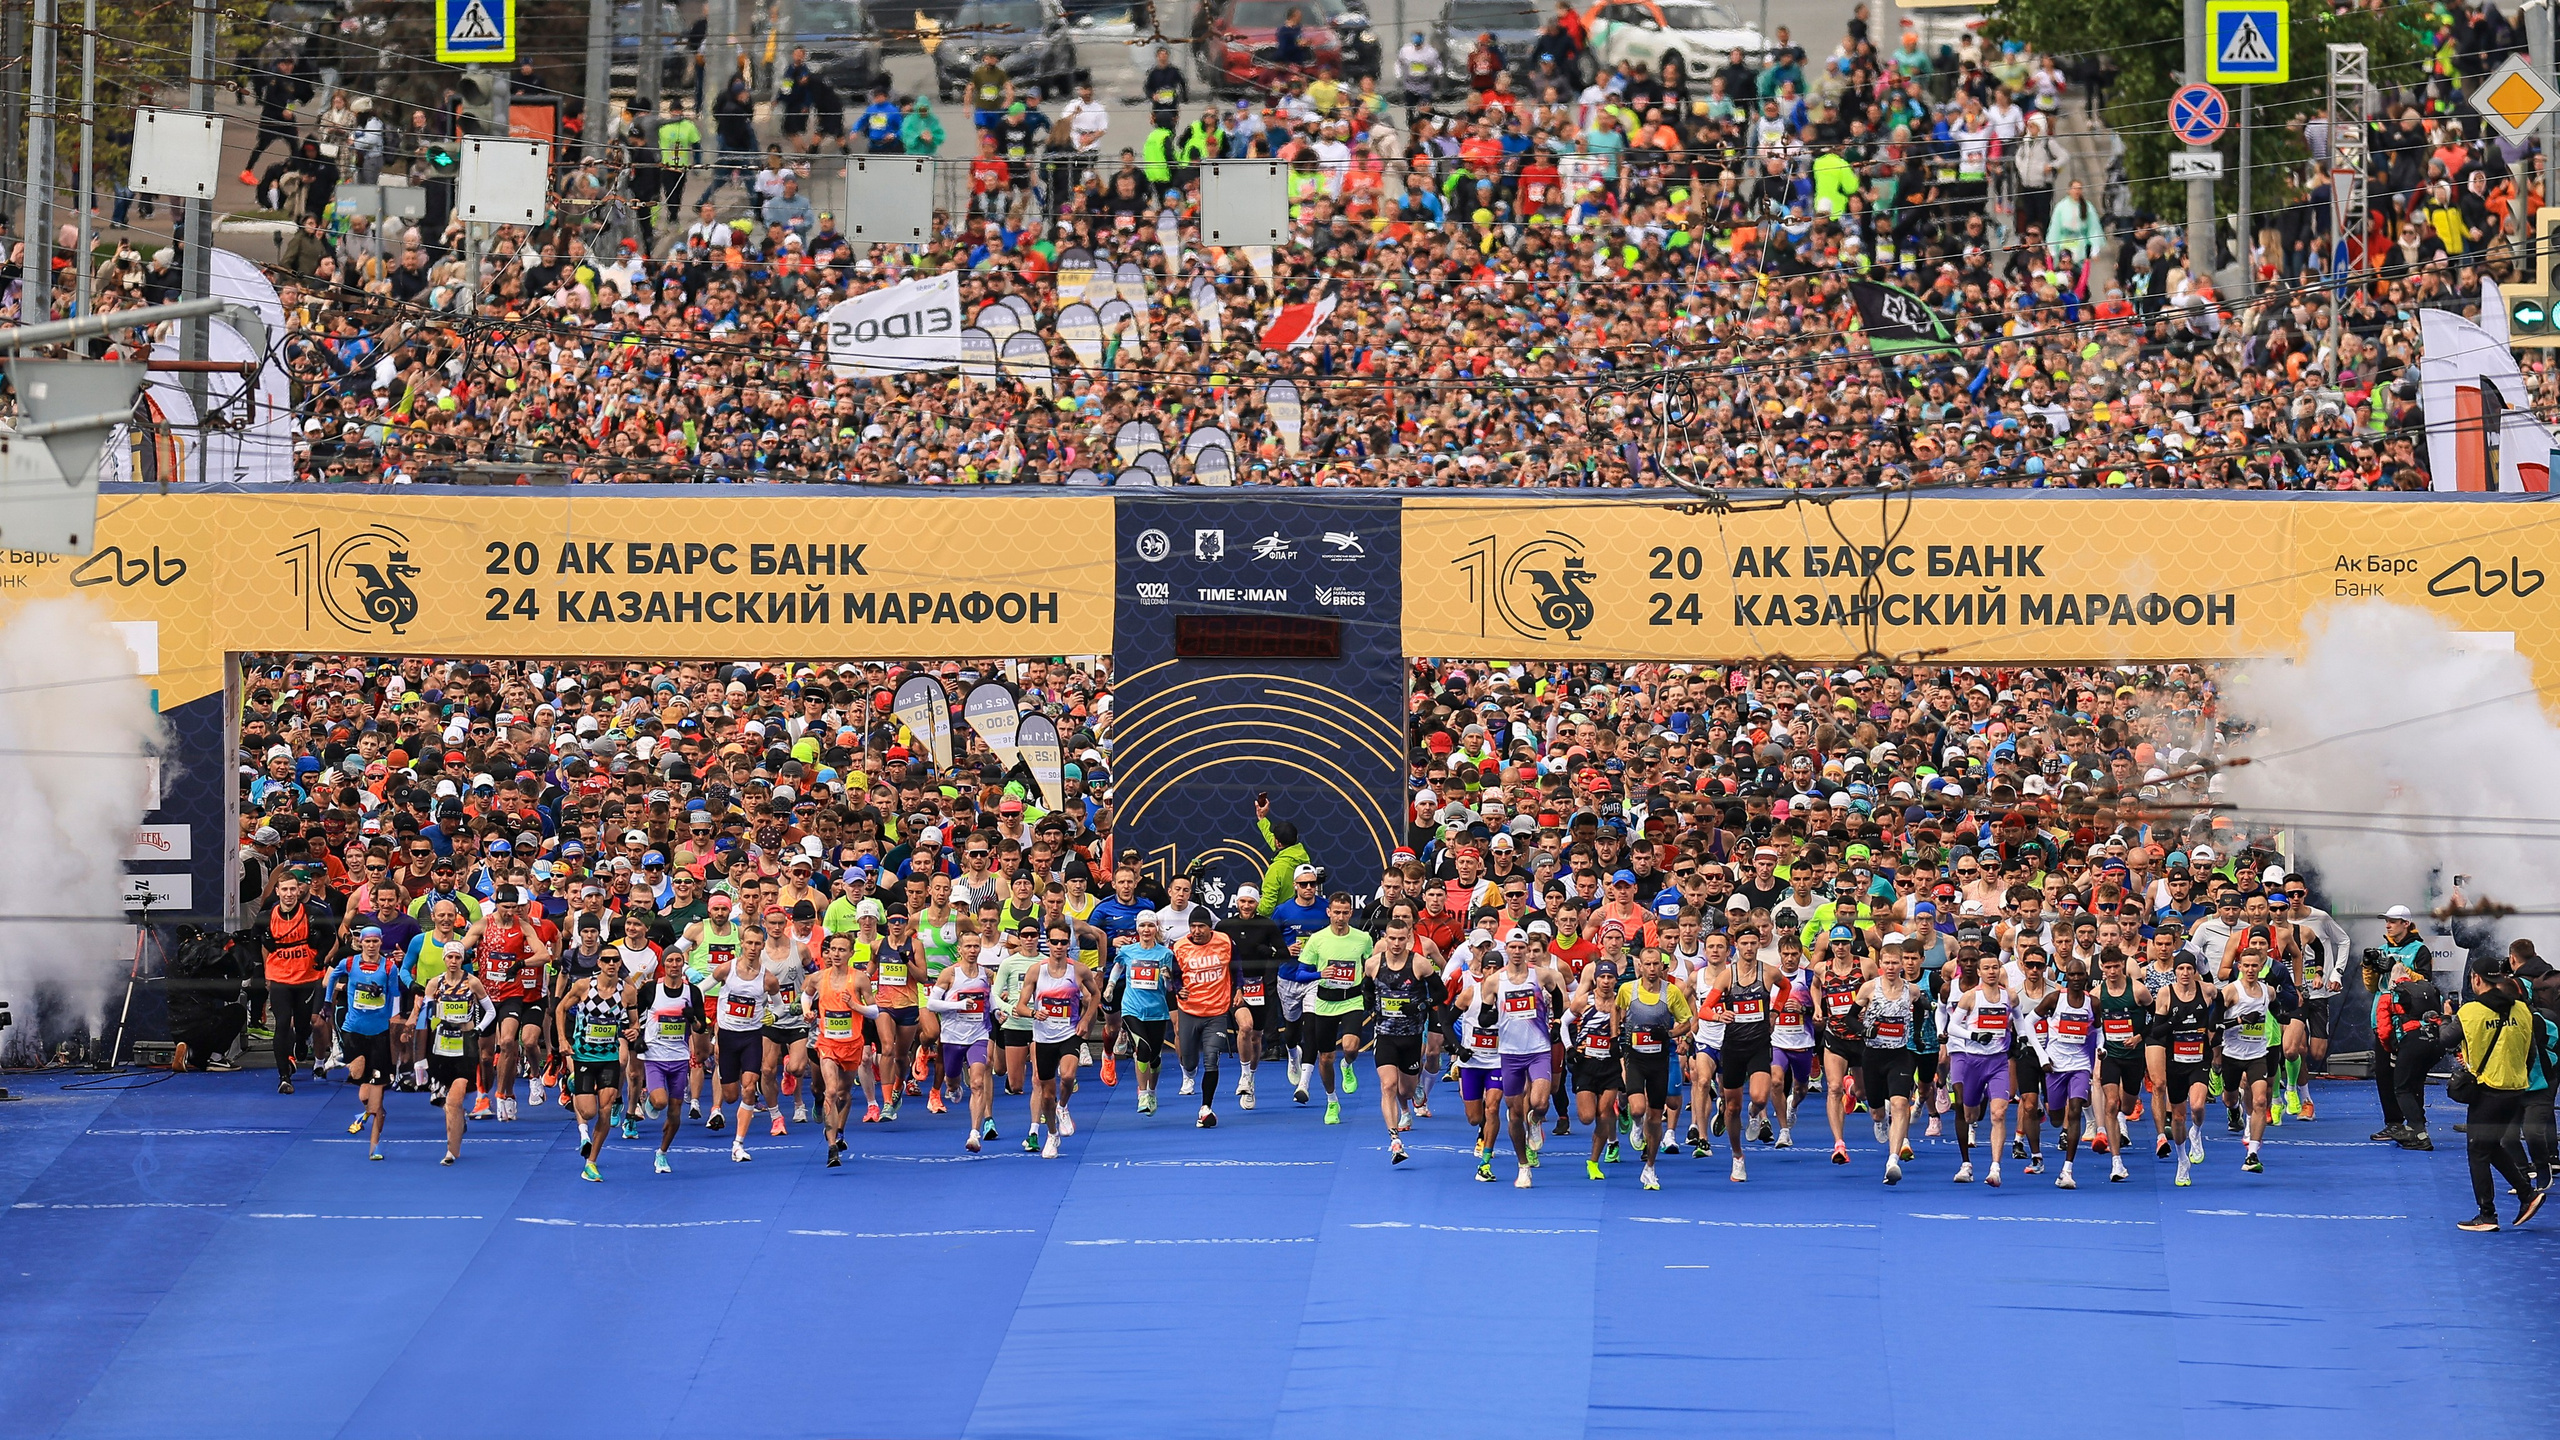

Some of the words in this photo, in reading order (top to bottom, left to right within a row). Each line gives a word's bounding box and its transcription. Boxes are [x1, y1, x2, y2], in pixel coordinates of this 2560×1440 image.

[485, 541, 540, 576] 20
[556, 542, 616, 575] АК
[626, 542, 739, 577] БАРС
[750, 543, 869, 577] БАНК
[1648, 546, 1703, 580] 20
[1732, 545, 1791, 578] АК
[1803, 545, 1916, 578] БАРС
[1926, 545, 2046, 577] БАНК
[2334, 555, 2362, 572] Ак
[2367, 555, 2418, 576] Барс
[0, 574, 28, 588] нк
[2334, 579, 2384, 597] Банк
[485, 587, 540, 622] 24
[557, 583, 830, 625] КАЗАНСКИЙ
[843, 590, 1059, 625] МАРАФОН
[1332, 596, 1366, 606] BRICS
[1648, 592, 1703, 626] 24
[1733, 585, 2007, 627] КАЗАНСКИЙ
[2020, 592, 2235, 626] МАРАФОН
[276, 948, 309, 960] GUIDE
[717, 953, 729, 962] 58
[497, 961, 509, 969] 62
[1188, 954, 1221, 970] GUIA
[1140, 968, 1152, 977] 65
[1838, 995, 1850, 1004] 16
[1516, 1000, 1528, 1009] 57
[1744, 1003, 1756, 1012] 35
[735, 1006, 746, 1015] 41
[1051, 1005, 1063, 1014] 63
[829, 1019, 849, 1027] 5005
[1784, 1015, 1797, 1024] 23
[593, 1025, 613, 1034] 5007
[2036, 1023, 2043, 1031] 4
[1481, 1038, 1493, 1046] 32
[1596, 1038, 1608, 1047] 56
